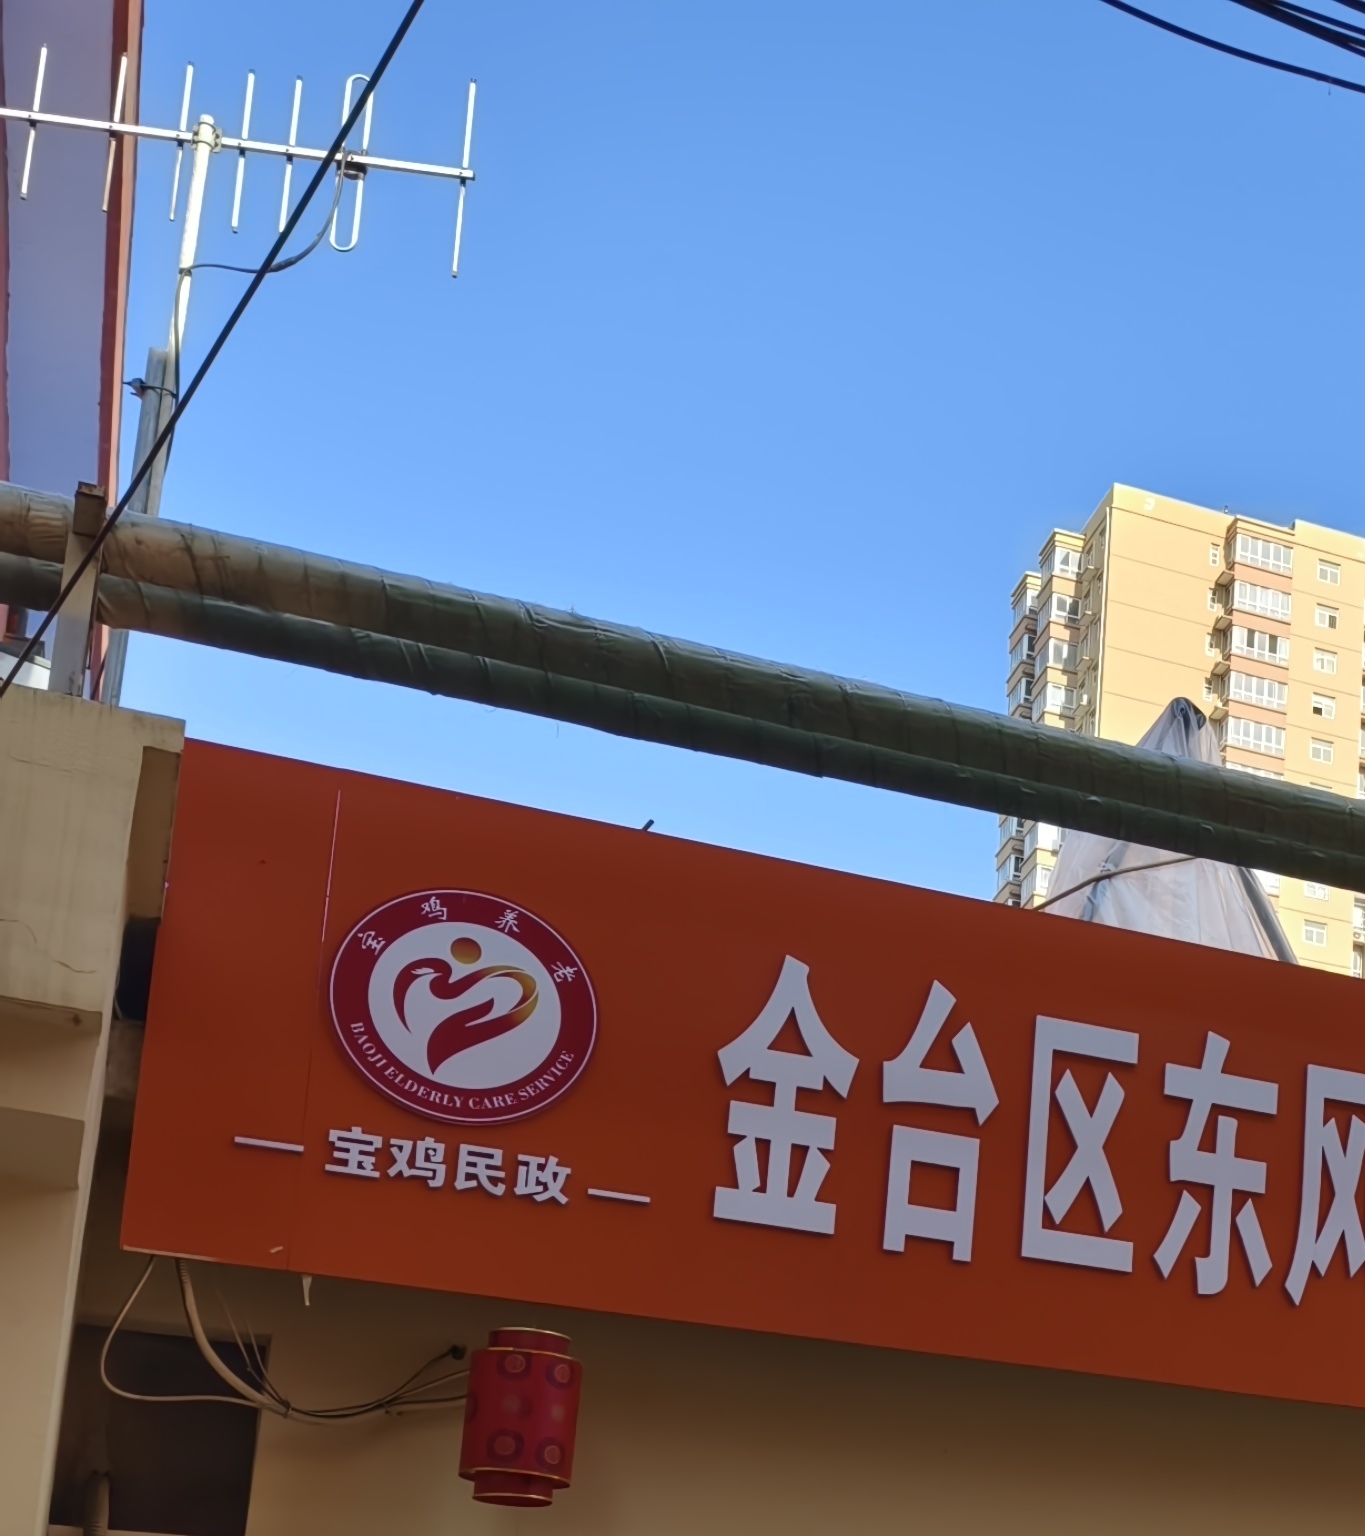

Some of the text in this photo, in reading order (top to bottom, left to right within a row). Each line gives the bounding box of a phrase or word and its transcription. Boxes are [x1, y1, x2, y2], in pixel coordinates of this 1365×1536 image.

[350, 1021, 575, 1110] BAOJI ELDERLY CARE SERVICE
[325, 1126, 572, 1205] 宝鸡民政
